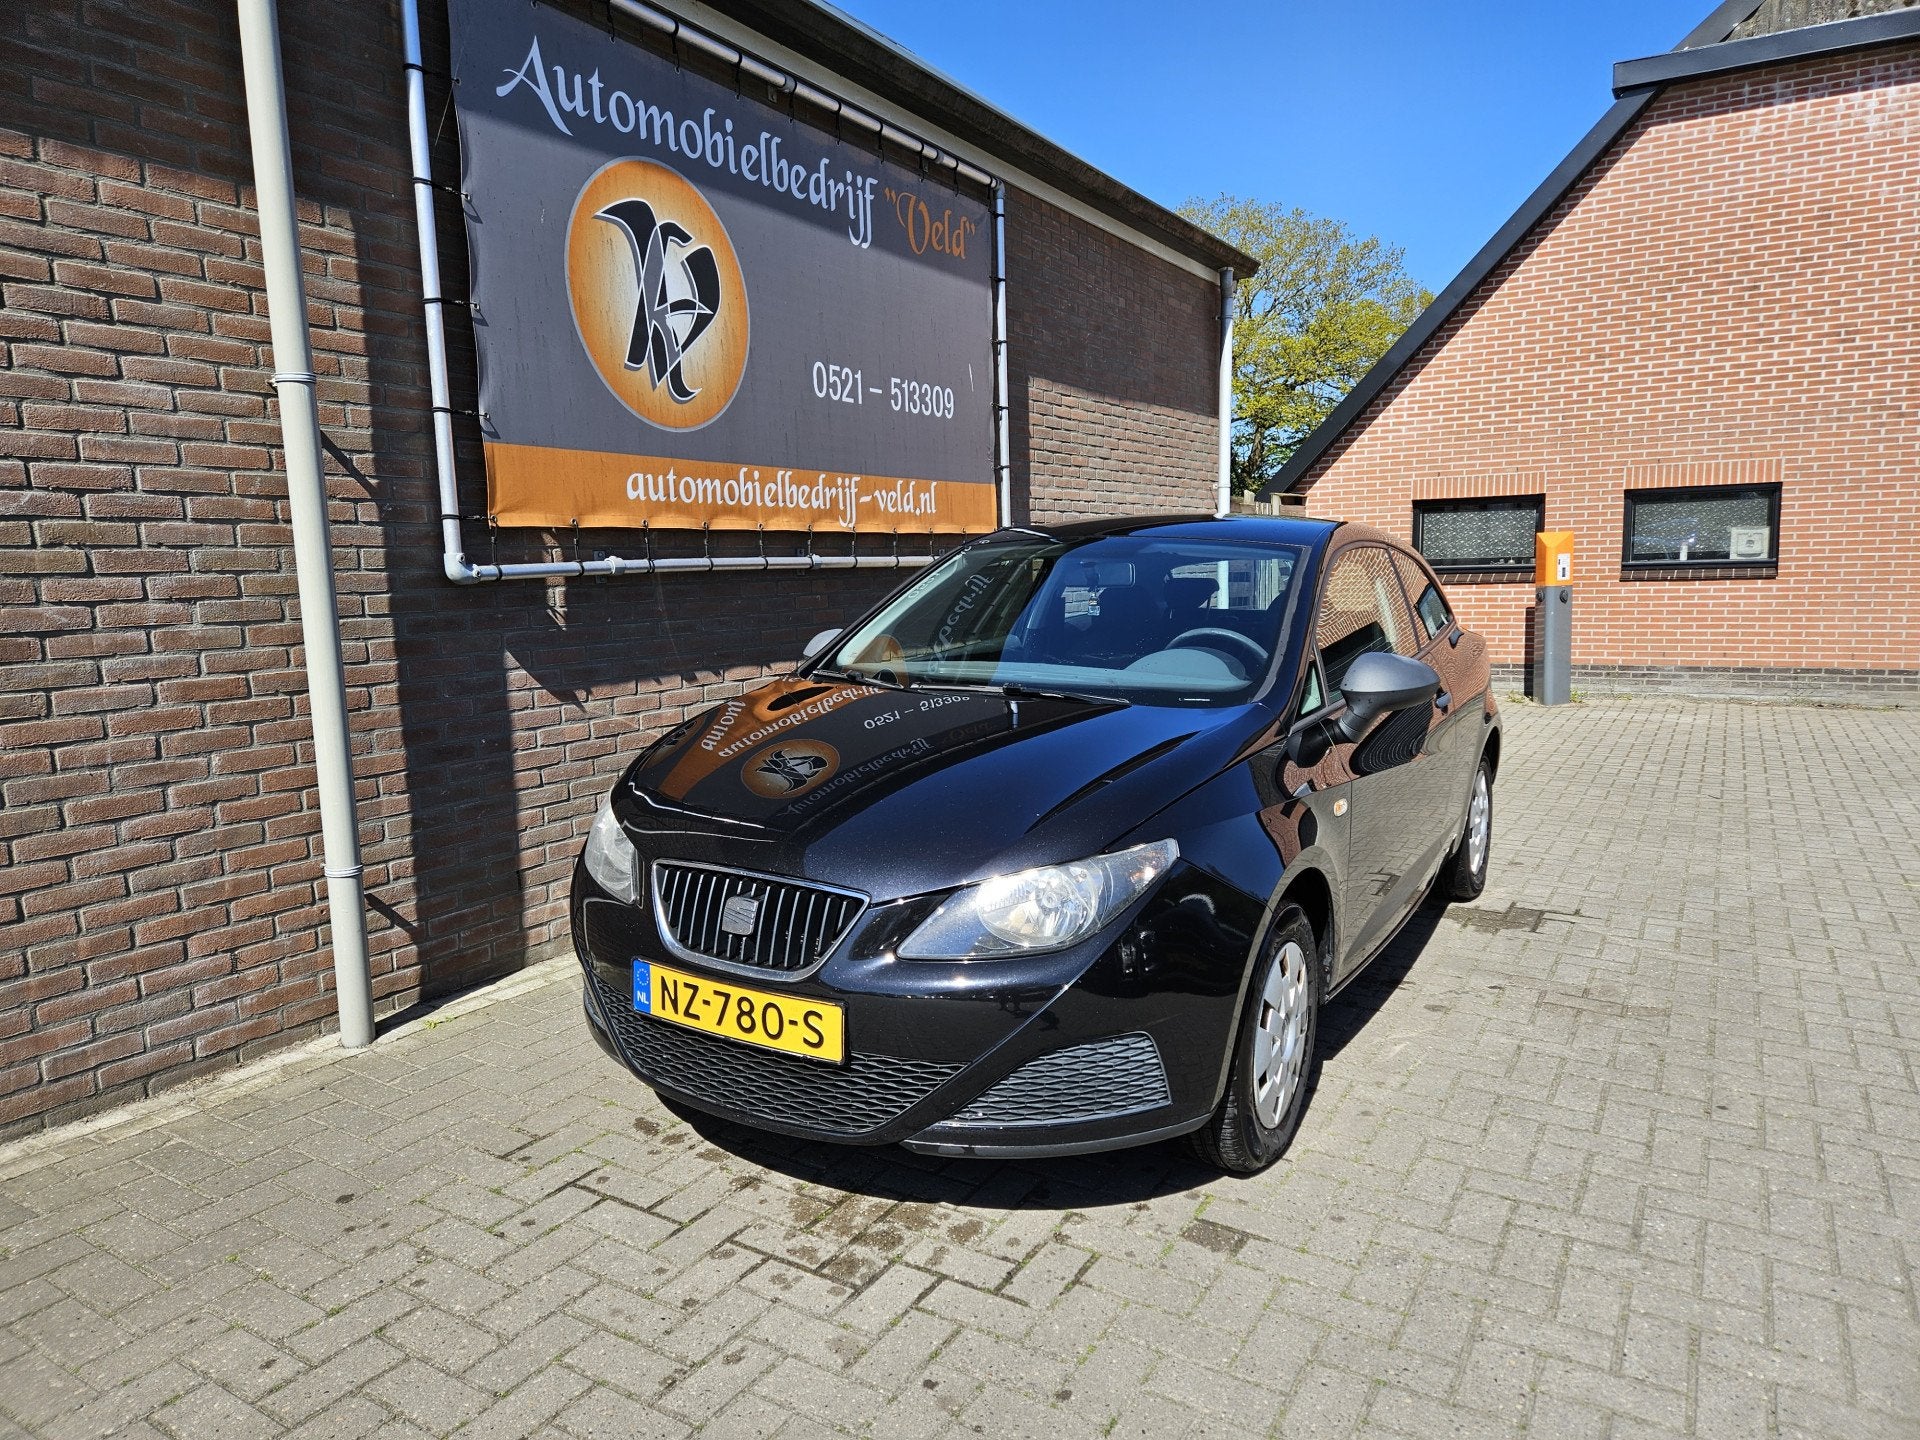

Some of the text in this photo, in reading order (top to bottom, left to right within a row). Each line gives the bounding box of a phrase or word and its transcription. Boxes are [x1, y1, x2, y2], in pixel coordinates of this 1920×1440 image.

[495, 35, 879, 249] Automobielbedrijf
[812, 361, 864, 405] 0521
[890, 377, 954, 419] 513309
[626, 467, 938, 528] automobielbedrijf-veld.nl
[636, 990, 650, 1005] NL
[660, 975, 825, 1049] NZ-780-S
